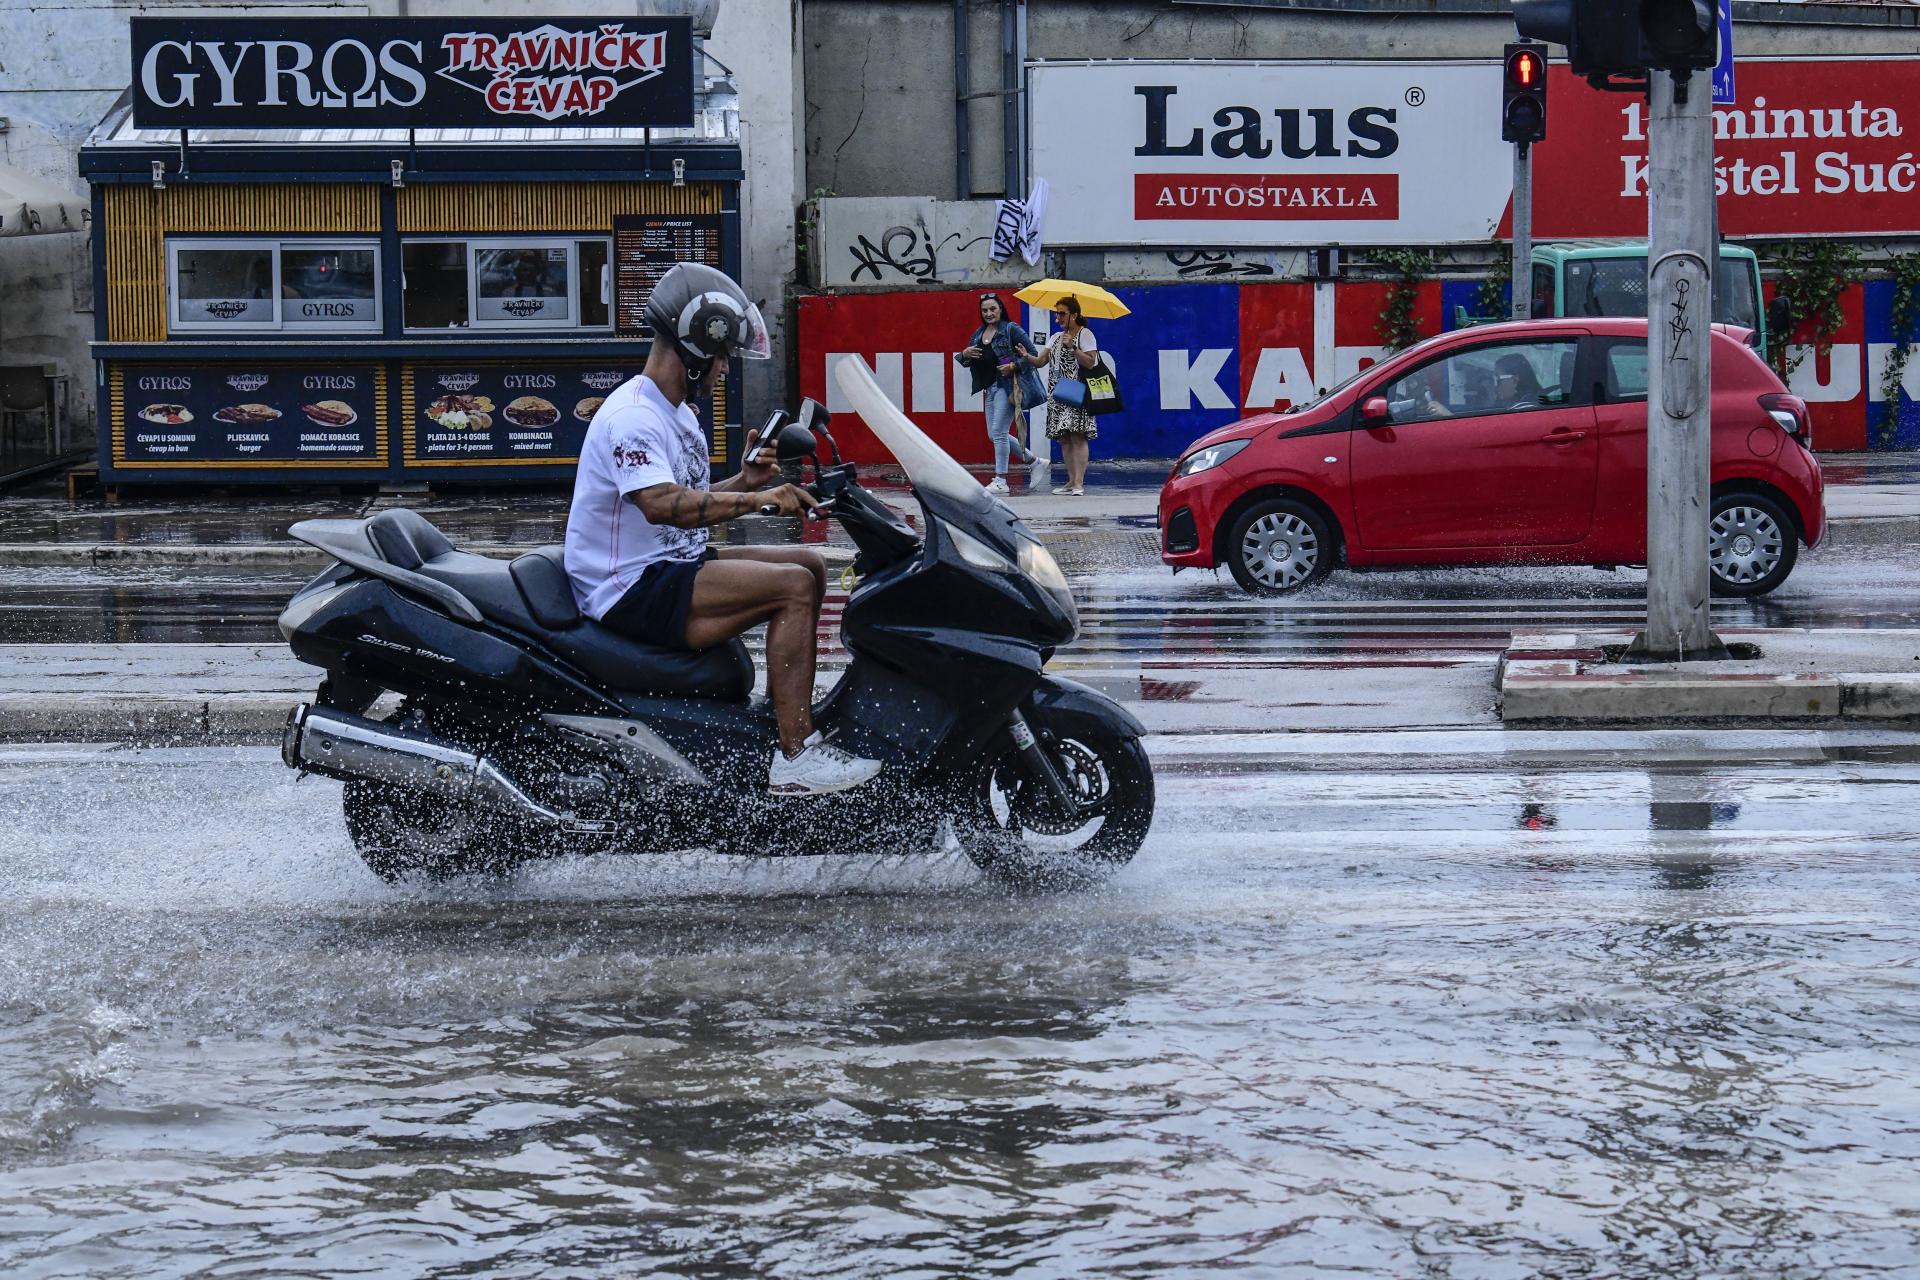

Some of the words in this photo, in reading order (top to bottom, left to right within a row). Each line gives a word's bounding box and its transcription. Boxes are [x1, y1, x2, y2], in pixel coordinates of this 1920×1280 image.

[442, 25, 666, 71] TRAVNIČKI
[1134, 85, 1399, 159] Laus
[1815, 151, 1920, 194] Suć
[1156, 186, 1378, 207] AUTOSTAKLA
[161, 434, 166, 442] U
[167, 434, 196, 442] SOMUNU
[227, 433, 269, 442] PLJESKAVICA
[328, 433, 360, 441] KOBASICE
[427, 433, 446, 441] PLATA
[447, 433, 456, 441] ZA
[457, 433, 468, 441] 3-4
[468, 433, 490, 441] OSOBE
[508, 432, 553, 440] KOMBINACIJA
[168, 444, 175, 452] in
[175, 444, 189, 452] bun
[239, 444, 261, 453] burger
[300, 443, 336, 451] homemade
[337, 444, 364, 453] sausage
[428, 442, 445, 452] plate
[446, 442, 456, 450] for
[457, 442, 468, 450] 3-4
[468, 443, 493, 452] persons
[513, 442, 535, 450] mixed
[536, 442, 552, 450] meat
[356, 634, 412, 653] SILVER
[415, 648, 456, 663] WING
